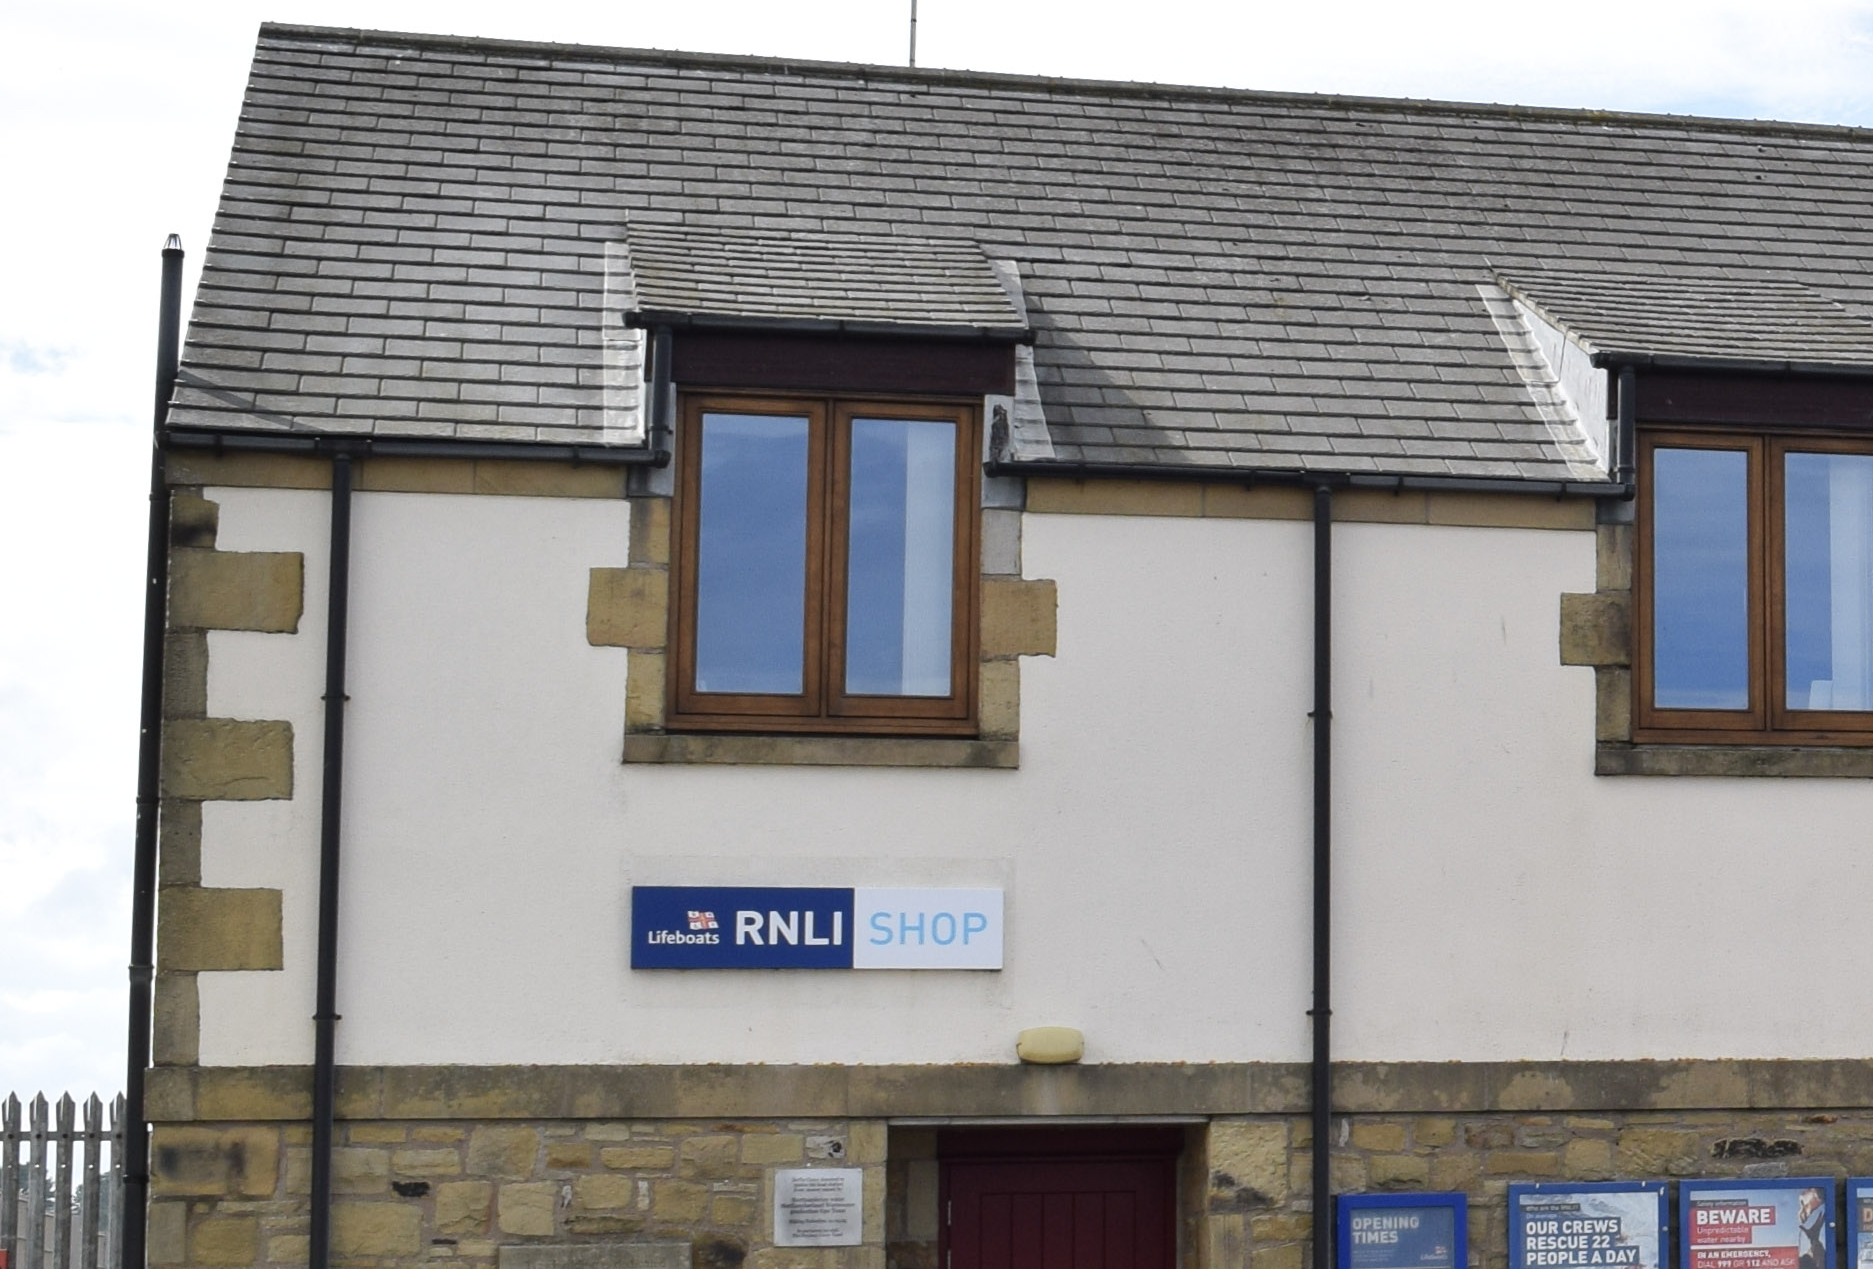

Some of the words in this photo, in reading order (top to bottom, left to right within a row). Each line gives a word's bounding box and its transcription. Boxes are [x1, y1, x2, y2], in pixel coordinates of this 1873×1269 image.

[648, 931, 720, 945] Lifeboats
[736, 911, 843, 946] RNLI
[870, 912, 987, 945] SHOP
[1697, 1209, 1770, 1225] BEWARE
[1864, 1208, 1873, 1222] D
[1352, 1217, 1419, 1230] OPENING
[1526, 1221, 1558, 1234] OUR
[1562, 1220, 1618, 1234] CREWS
[1353, 1231, 1398, 1244] TIMES
[1697, 1227, 1749, 1235] Unpredictable
[1527, 1236, 1588, 1250] RESCUE
[1592, 1235, 1610, 1248] 22
[1527, 1251, 1587, 1265] PEOPLE
[1591, 1251, 1602, 1263] A
[1606, 1249, 1636, 1263] DAY
[1721, 1250, 1771, 1258] EMERGENCY,
